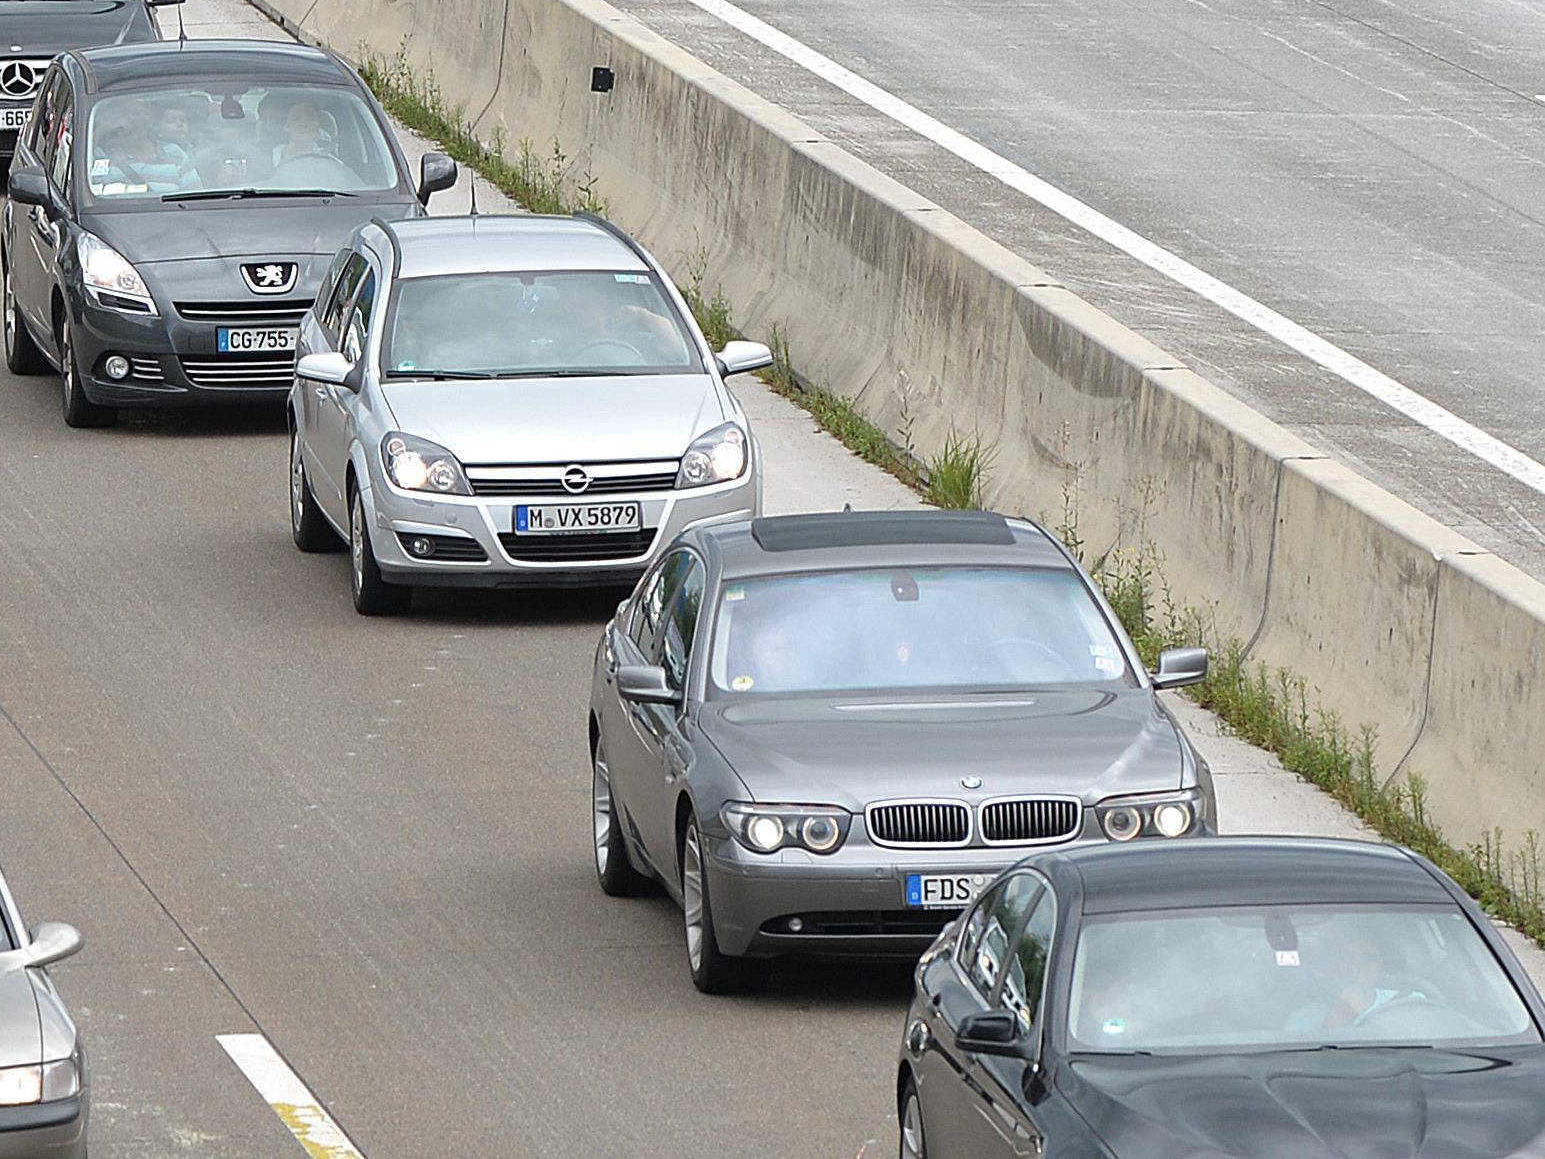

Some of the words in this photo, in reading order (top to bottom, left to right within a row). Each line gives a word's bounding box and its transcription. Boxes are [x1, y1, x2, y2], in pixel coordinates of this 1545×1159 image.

[530, 509, 542, 528] M
[557, 507, 583, 527] VX
[587, 505, 636, 525] 5879
[923, 878, 970, 901] FDS
